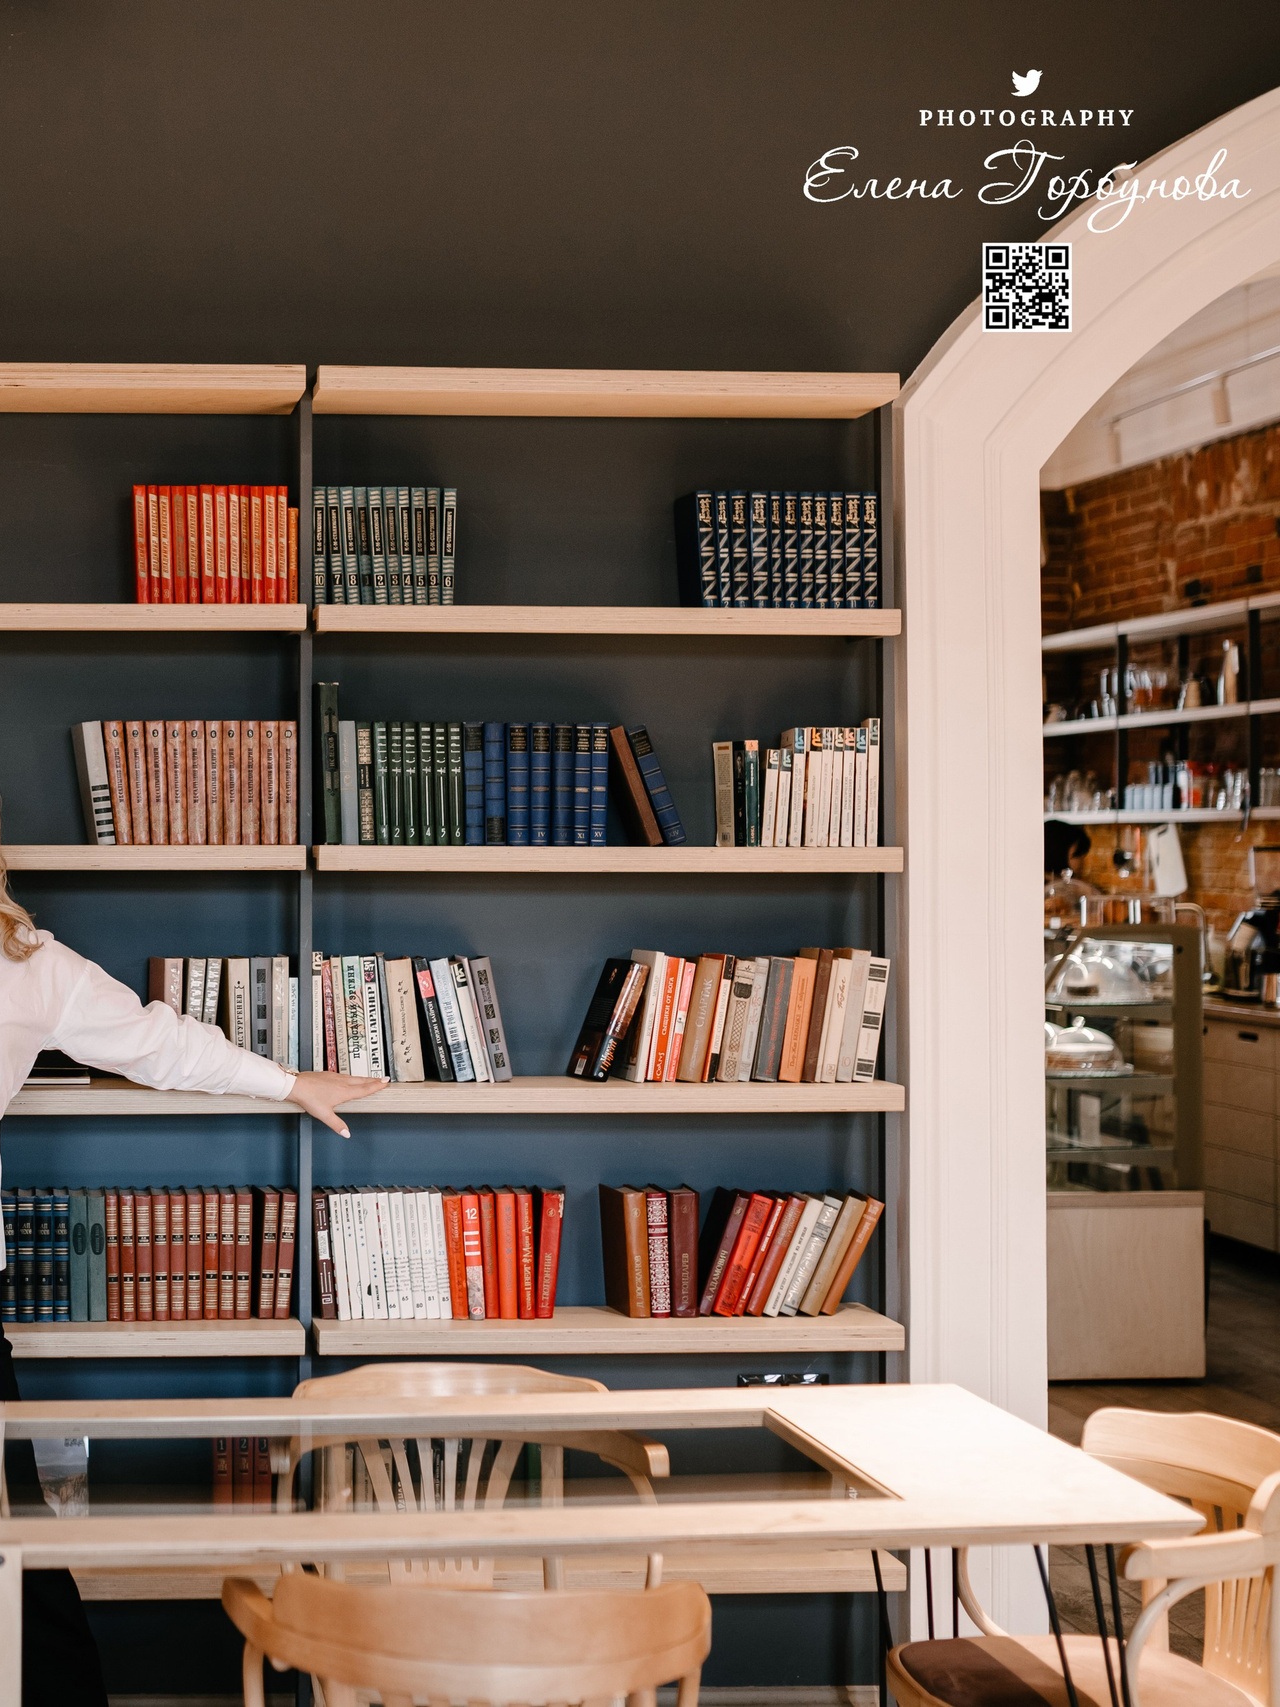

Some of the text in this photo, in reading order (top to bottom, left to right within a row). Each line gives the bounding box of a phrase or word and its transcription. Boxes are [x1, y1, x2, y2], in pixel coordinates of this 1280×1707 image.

[315, 574, 324, 586] 10
[333, 574, 341, 585] 7
[349, 574, 357, 585] 8
[376, 574, 384, 586] 2
[391, 575, 399, 585] 3
[405, 575, 412, 585] 4
[417, 576, 425, 586] 5
[430, 576, 438, 586] 9
[444, 577, 452, 587] 6
[381, 828, 387, 837] 1
[393, 828, 400, 837] 2
[409, 828, 415, 837] 3
[425, 827, 431, 837] 4
[440, 828, 446, 837] 5
[455, 828, 461, 837] 6
[661, 977, 675, 1035] СЫЩИКИ ОТ БОГА
[695, 978, 713, 1028] СПАРТАК
[346, 964, 360, 1059] ПОЛОСАТЫЙ ЭРГЕНИ
[399, 1012, 407, 1037] Александр
[428, 1001, 448, 1069] ДЖОРДЖ ГОРДОН БАЙРОН
[465, 1208, 477, 1220] 12
[523, 1265, 531, 1290] ЦВЕЙГ
[541, 1253, 552, 1301] ТЮТЮННИК
[634, 1255, 644, 1299] ДОСЖАНОВ
[681, 1253, 689, 1294] БОНДАРЕВ
[705, 1249, 728, 1302] А. АДАМОВИЧ
[219, 1439, 225, 1450] 1
[240, 1438, 247, 1449] 2
